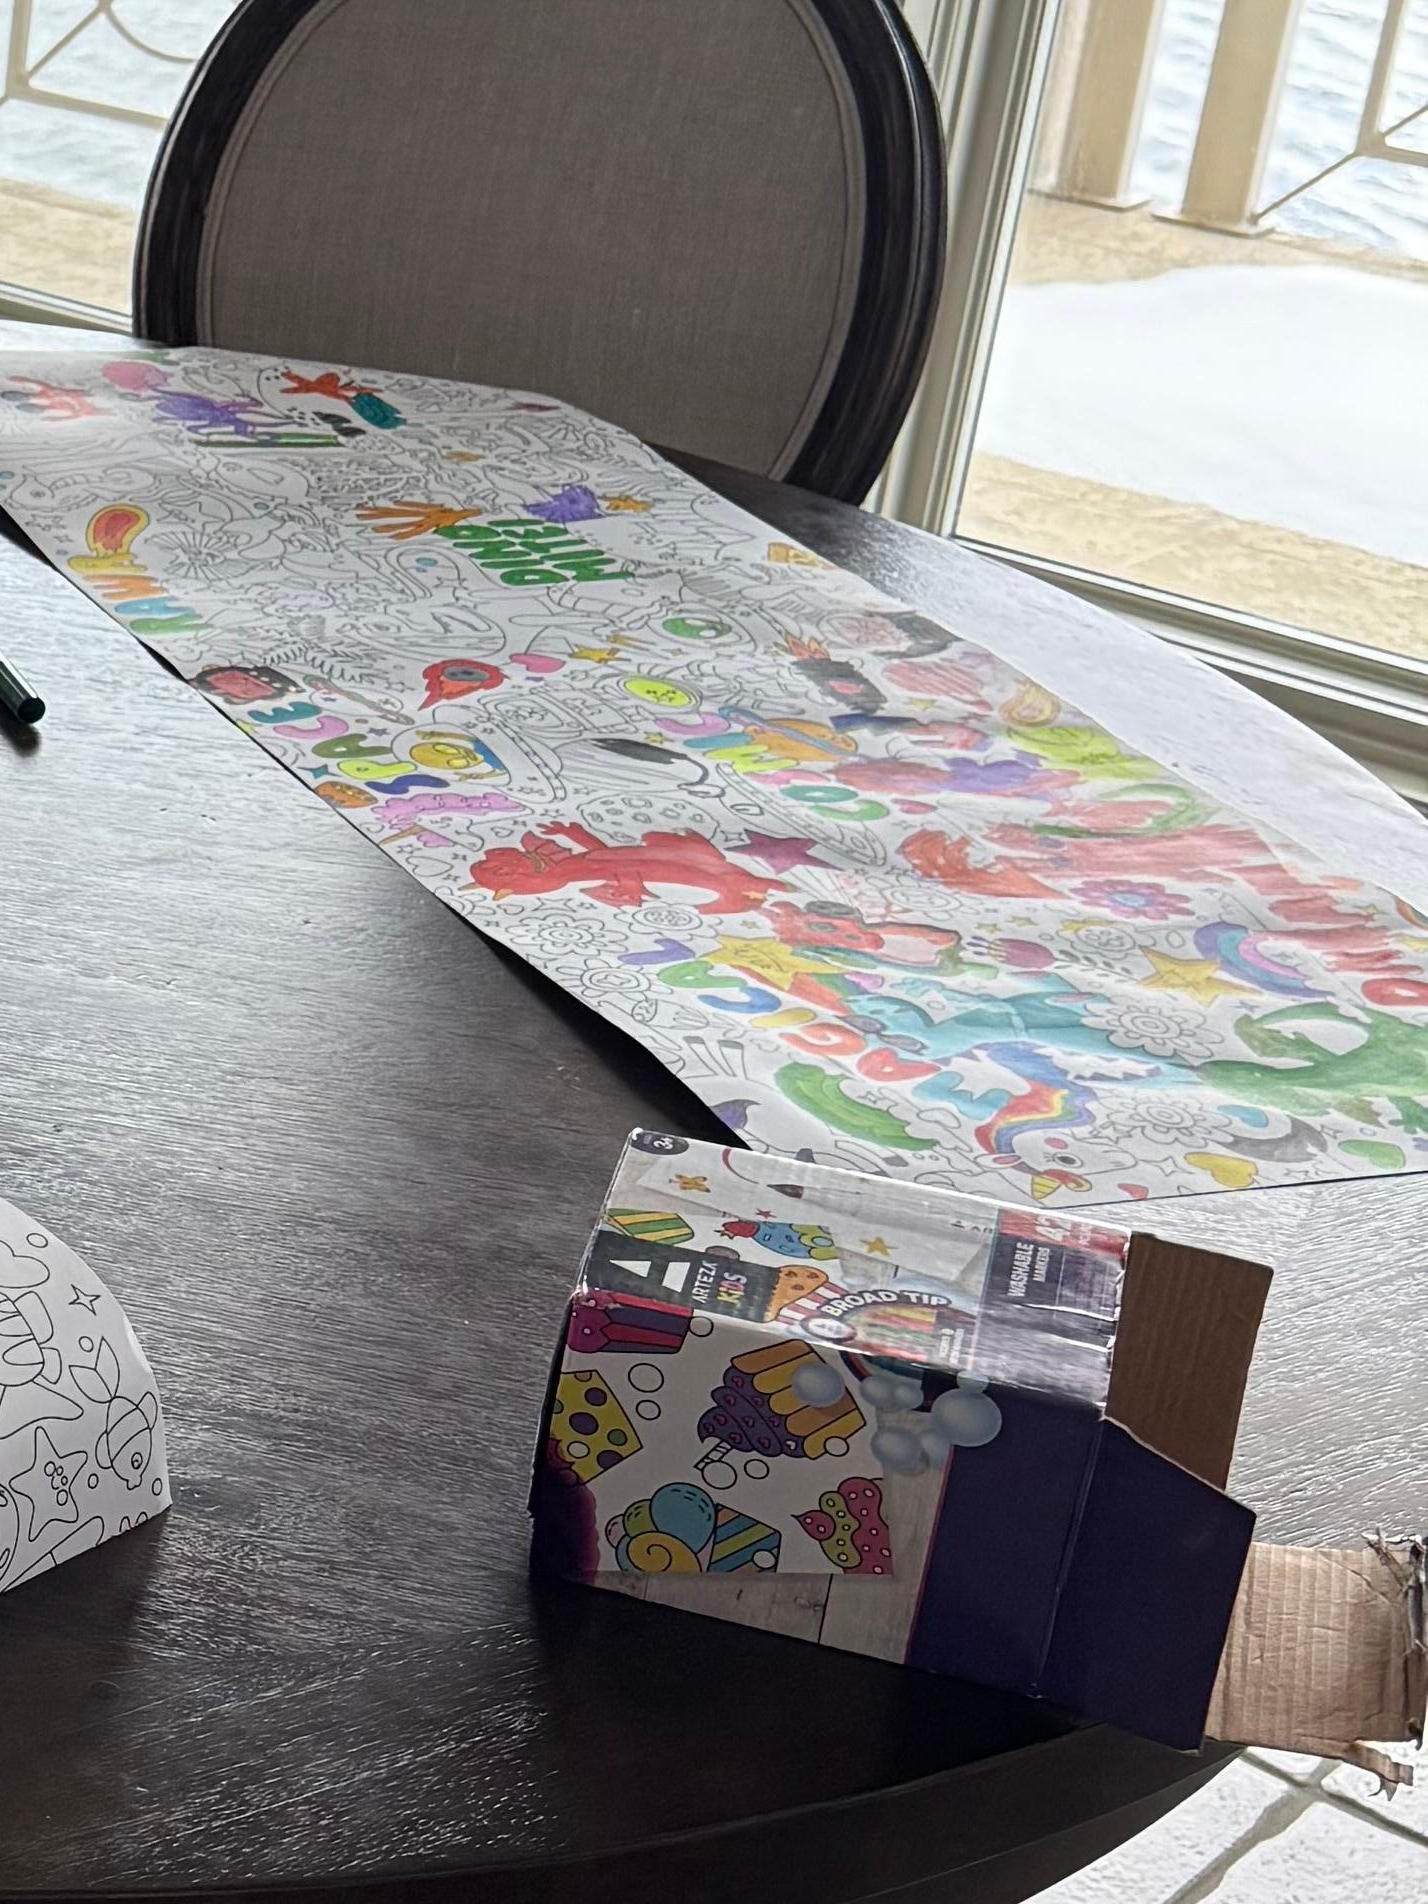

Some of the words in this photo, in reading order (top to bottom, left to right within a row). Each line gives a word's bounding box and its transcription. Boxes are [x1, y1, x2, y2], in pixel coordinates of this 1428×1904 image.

[247, 701, 451, 795] SPACE
[618, 938, 1014, 1120] MAGICAL
[692, 1260, 719, 1304] ARTEZA
[1007, 1242, 1035, 1297] WASHABLE
[1032, 1247, 1050, 1283] MARKERS
[717, 1272, 748, 1305] KIDS
[821, 1291, 898, 1317] BROAD
[903, 1291, 949, 1305] TIP
